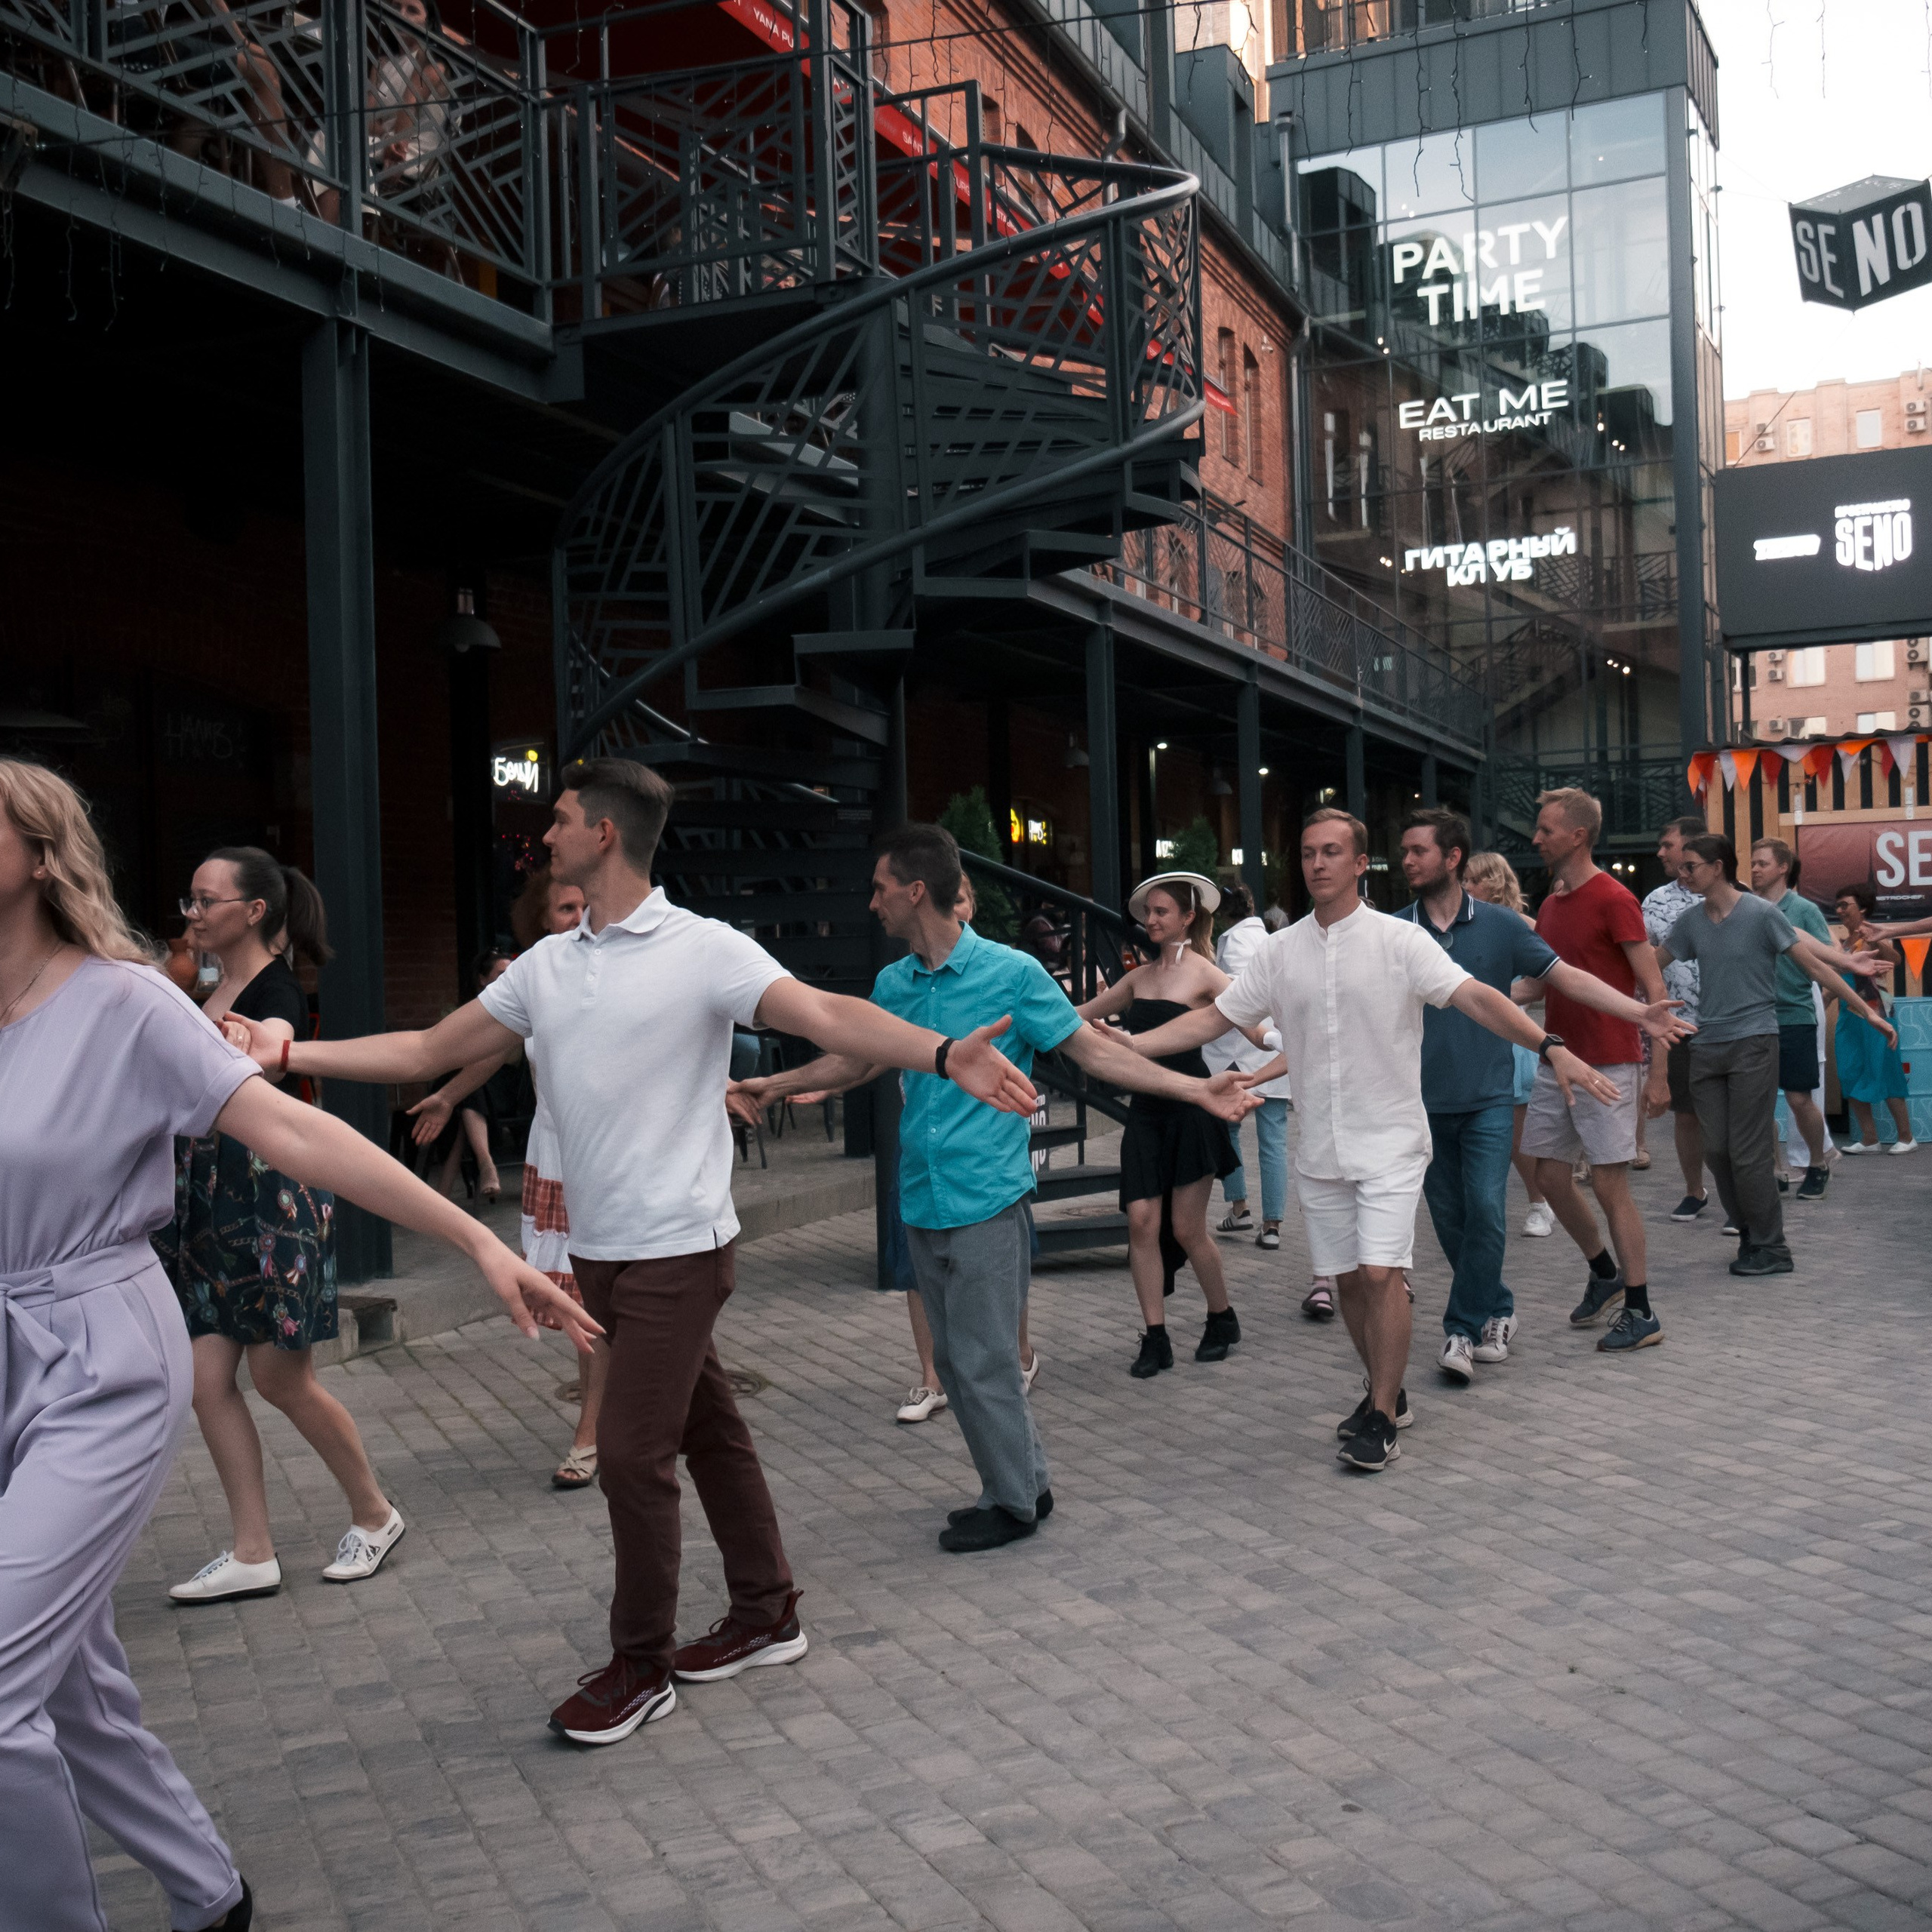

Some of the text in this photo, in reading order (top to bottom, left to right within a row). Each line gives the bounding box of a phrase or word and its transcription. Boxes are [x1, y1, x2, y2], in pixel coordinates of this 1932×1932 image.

[1393, 216, 1568, 284] PARTY
[1417, 269, 1546, 326] TIME
[1398, 379, 1569, 429] EAT ME
[1419, 411, 1552, 442] RESTAURANT
[1404, 527, 1577, 571] ГИТАРНЫЙ
[1835, 512, 1912, 572] SENO
[1447, 558, 1533, 587] КЛУБ
[1876, 831, 1932, 888] SE
